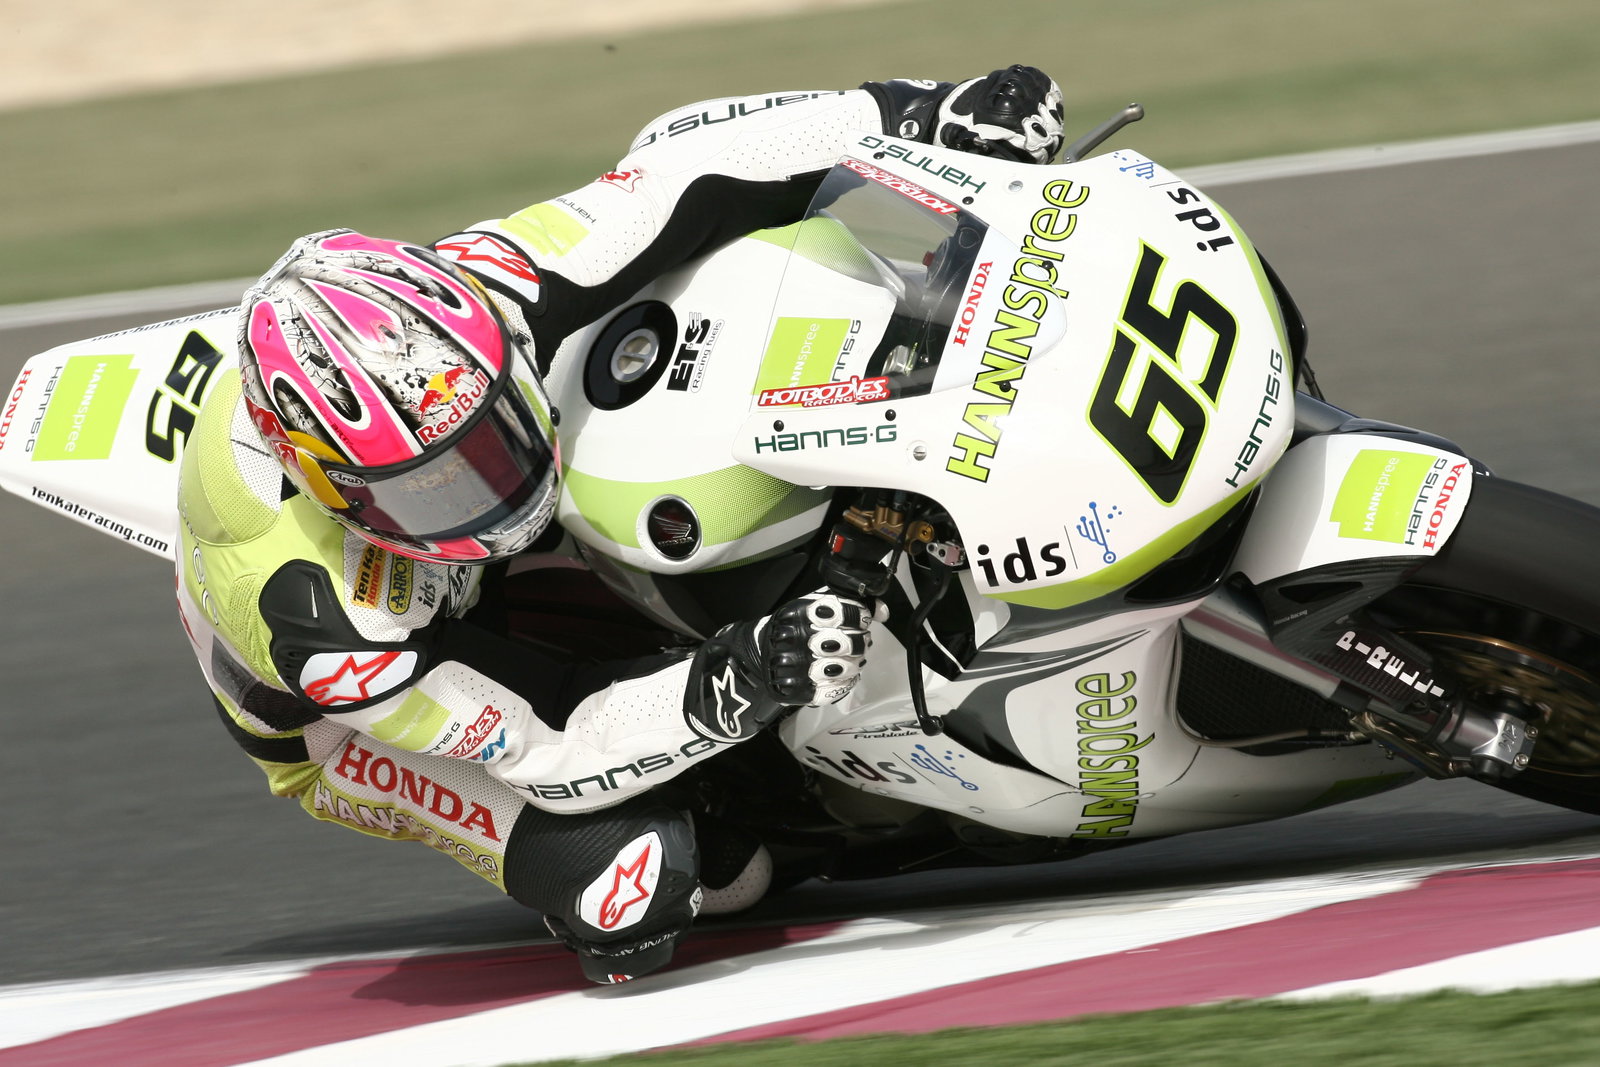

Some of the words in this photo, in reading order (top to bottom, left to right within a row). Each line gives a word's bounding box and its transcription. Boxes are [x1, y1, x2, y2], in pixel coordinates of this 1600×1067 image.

[1166, 187, 1235, 252] ids
[953, 261, 994, 347] HONDA
[666, 311, 711, 392] ETS
[692, 349, 712, 389] Racing
[706, 322, 722, 347] fuels
[789, 322, 820, 388] ANNspree
[1084, 236, 1242, 508] 65
[144, 329, 224, 464] 65
[1363, 456, 1400, 533] HANNspree
[1423, 462, 1468, 551] HONDA
[353, 572, 370, 602] Ten
[366, 562, 382, 606] Honda
[417, 580, 437, 609] ids
[977, 537, 1066, 587] ids
[1335, 630, 1445, 697] PIRELLI
[805, 745, 918, 785] ids
[853, 731, 919, 739] Fireblade
[335, 741, 502, 843] HONDA
